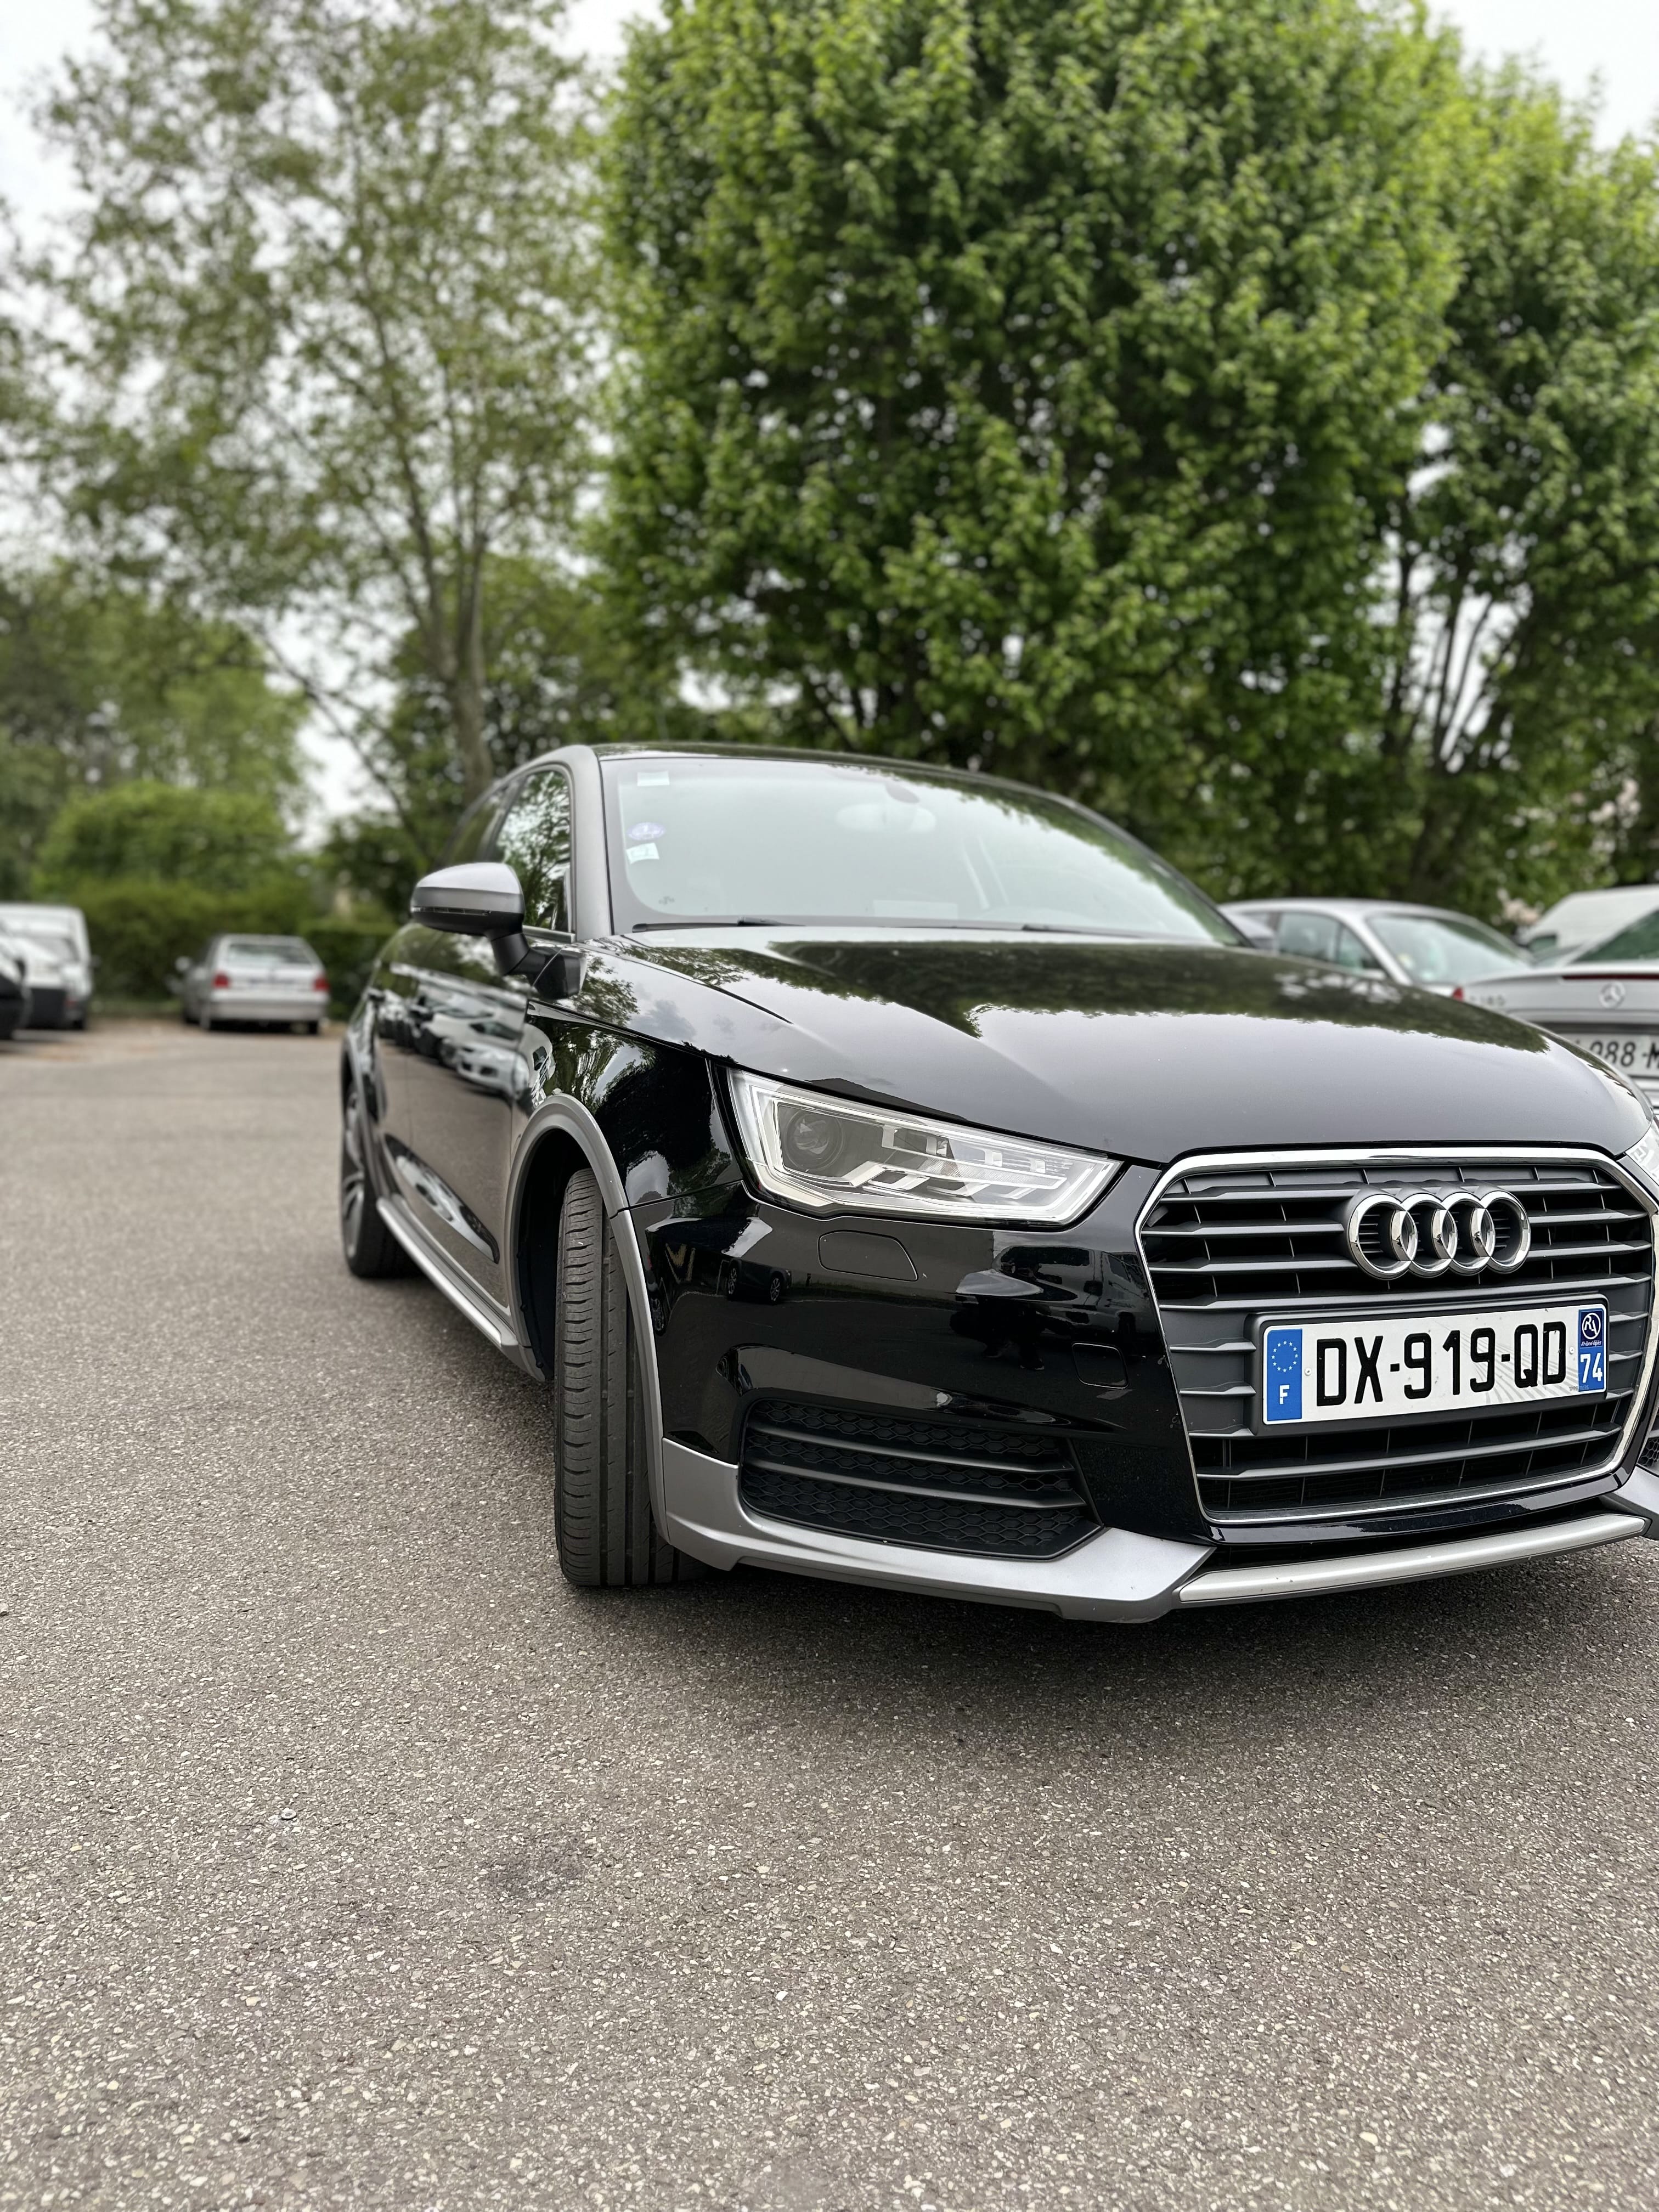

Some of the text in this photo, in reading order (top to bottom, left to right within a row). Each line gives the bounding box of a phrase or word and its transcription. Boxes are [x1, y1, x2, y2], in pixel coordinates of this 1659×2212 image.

[1316, 1321, 1566, 1407] DX-919-QD
[1580, 1352, 1603, 1383] 74
[1279, 1385, 1290, 1404] F
